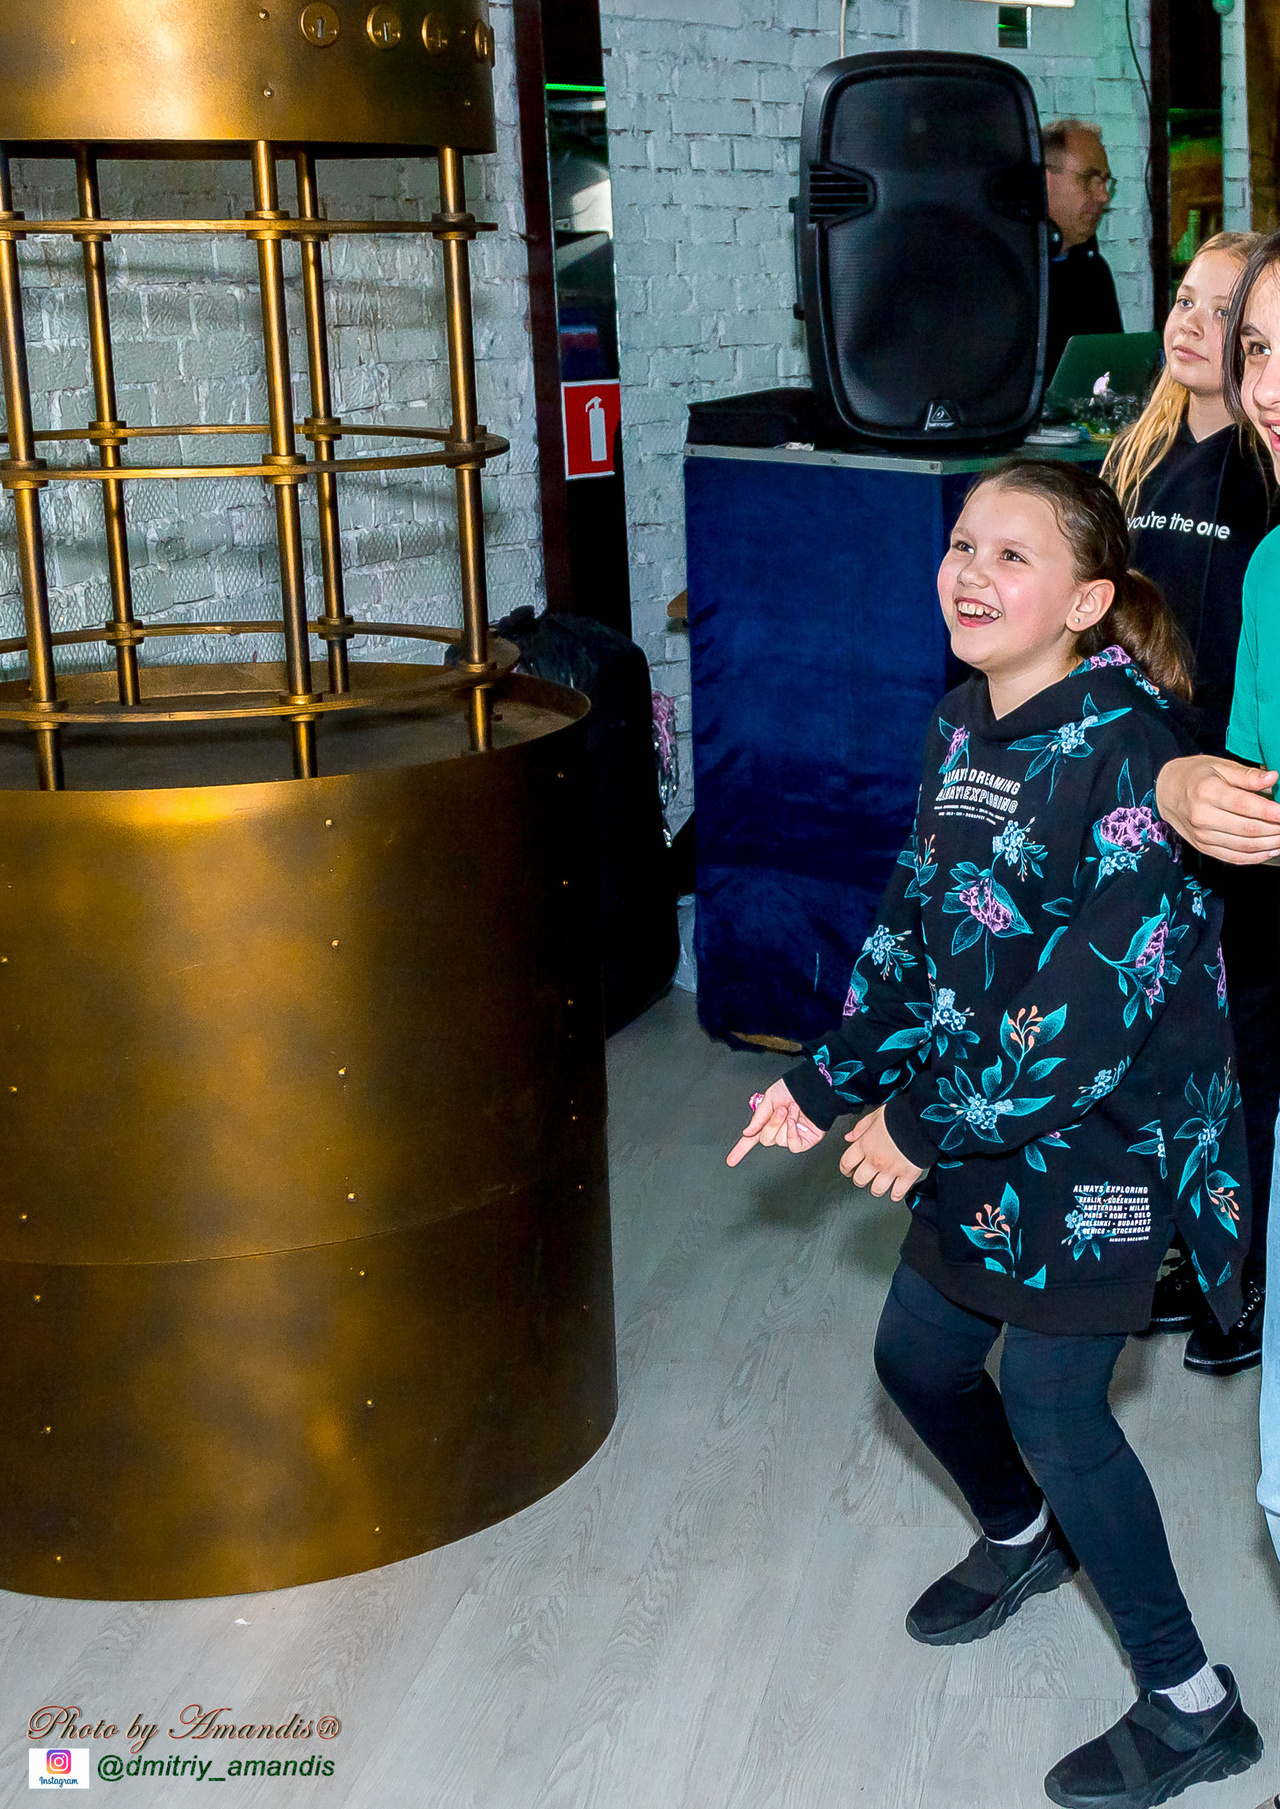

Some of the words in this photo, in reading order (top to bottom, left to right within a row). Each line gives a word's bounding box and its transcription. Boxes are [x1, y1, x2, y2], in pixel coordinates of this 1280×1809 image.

[1127, 510, 1167, 532] you're
[1169, 512, 1194, 533] the
[1196, 521, 1231, 540] one
[968, 768, 1021, 796] DREAMING
[1073, 1185, 1104, 1193] ALWAYS
[1106, 1186, 1149, 1194] EXPLORING
